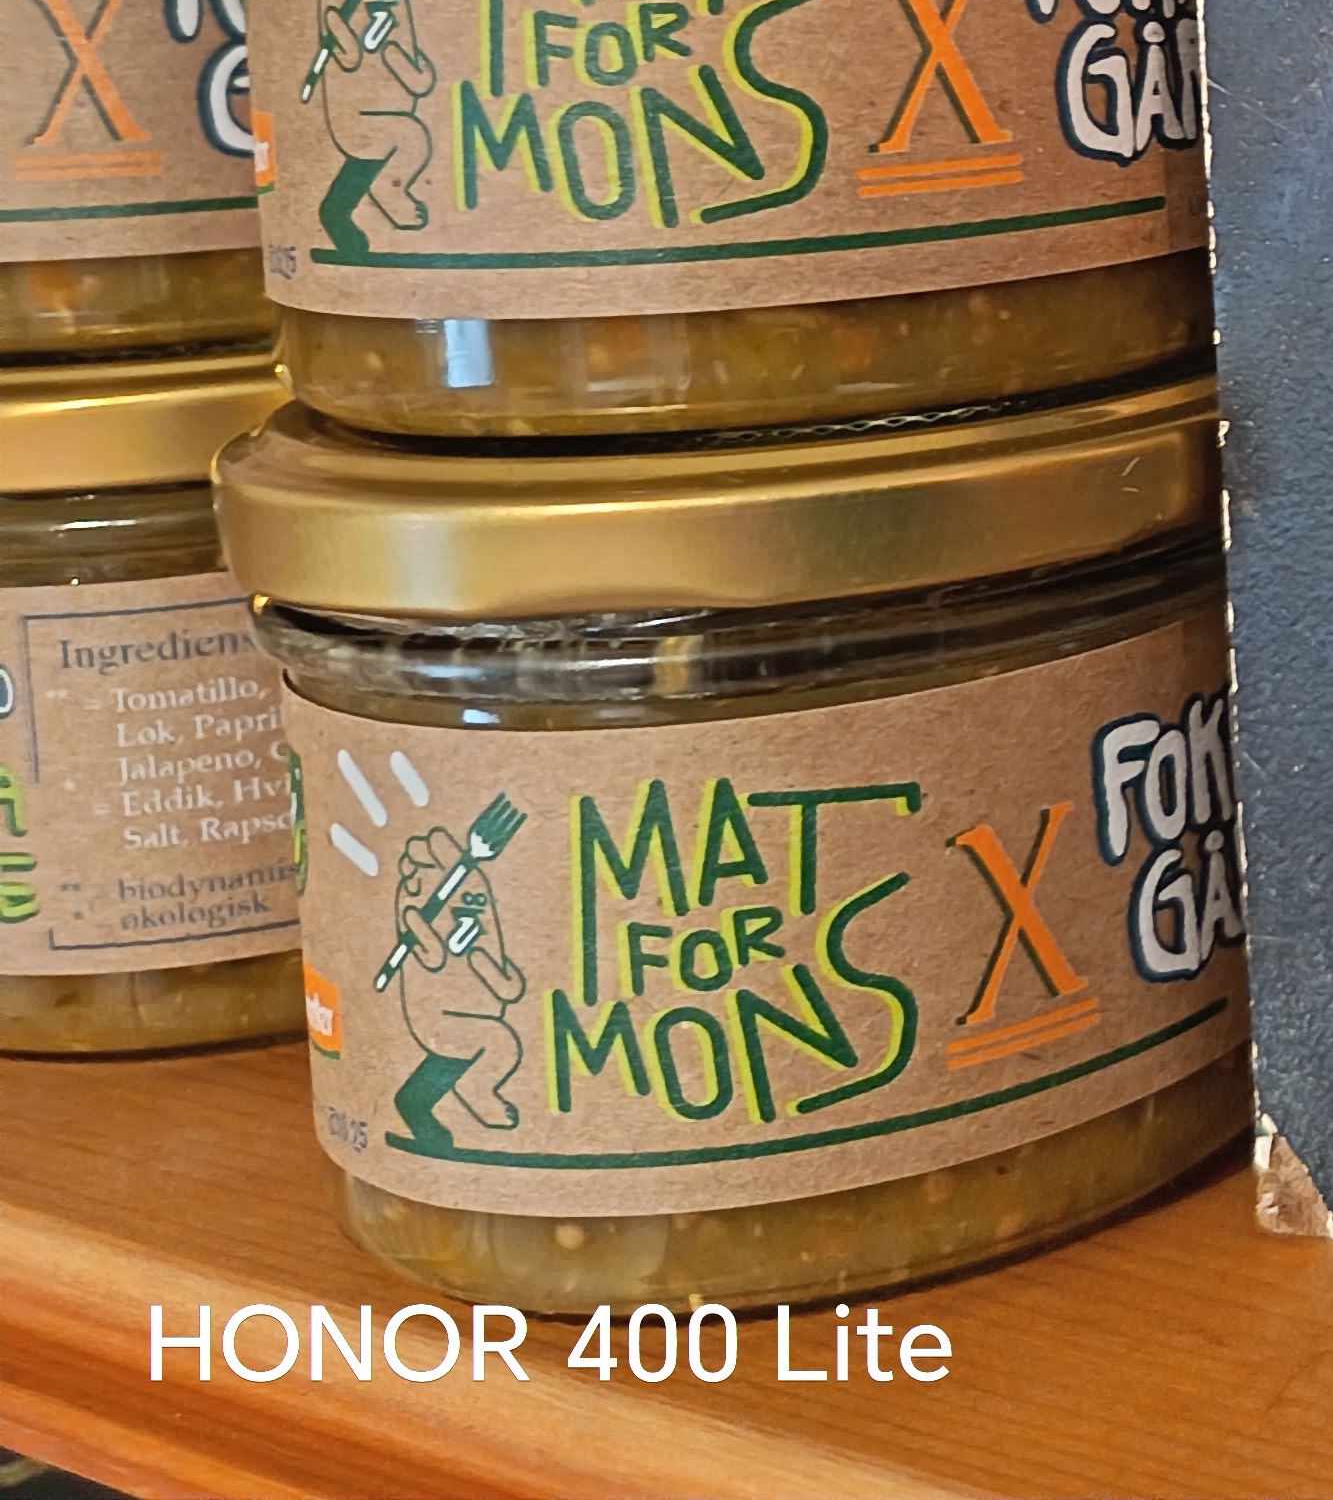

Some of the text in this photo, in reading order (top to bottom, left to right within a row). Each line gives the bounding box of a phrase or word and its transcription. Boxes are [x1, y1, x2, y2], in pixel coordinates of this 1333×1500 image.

[524, 1, 692, 89] FOR
[113, 676, 272, 713] Tomatillo,
[119, 749, 263, 787] Jalapeno,
[122, 784, 224, 818] Eddik,
[123, 822, 190, 851] Salt,
[572, 777, 926, 1006] MAT
[946, 801, 1090, 1026] X
[618, 906, 787, 996] FOR
[544, 871, 919, 1124] MONS
